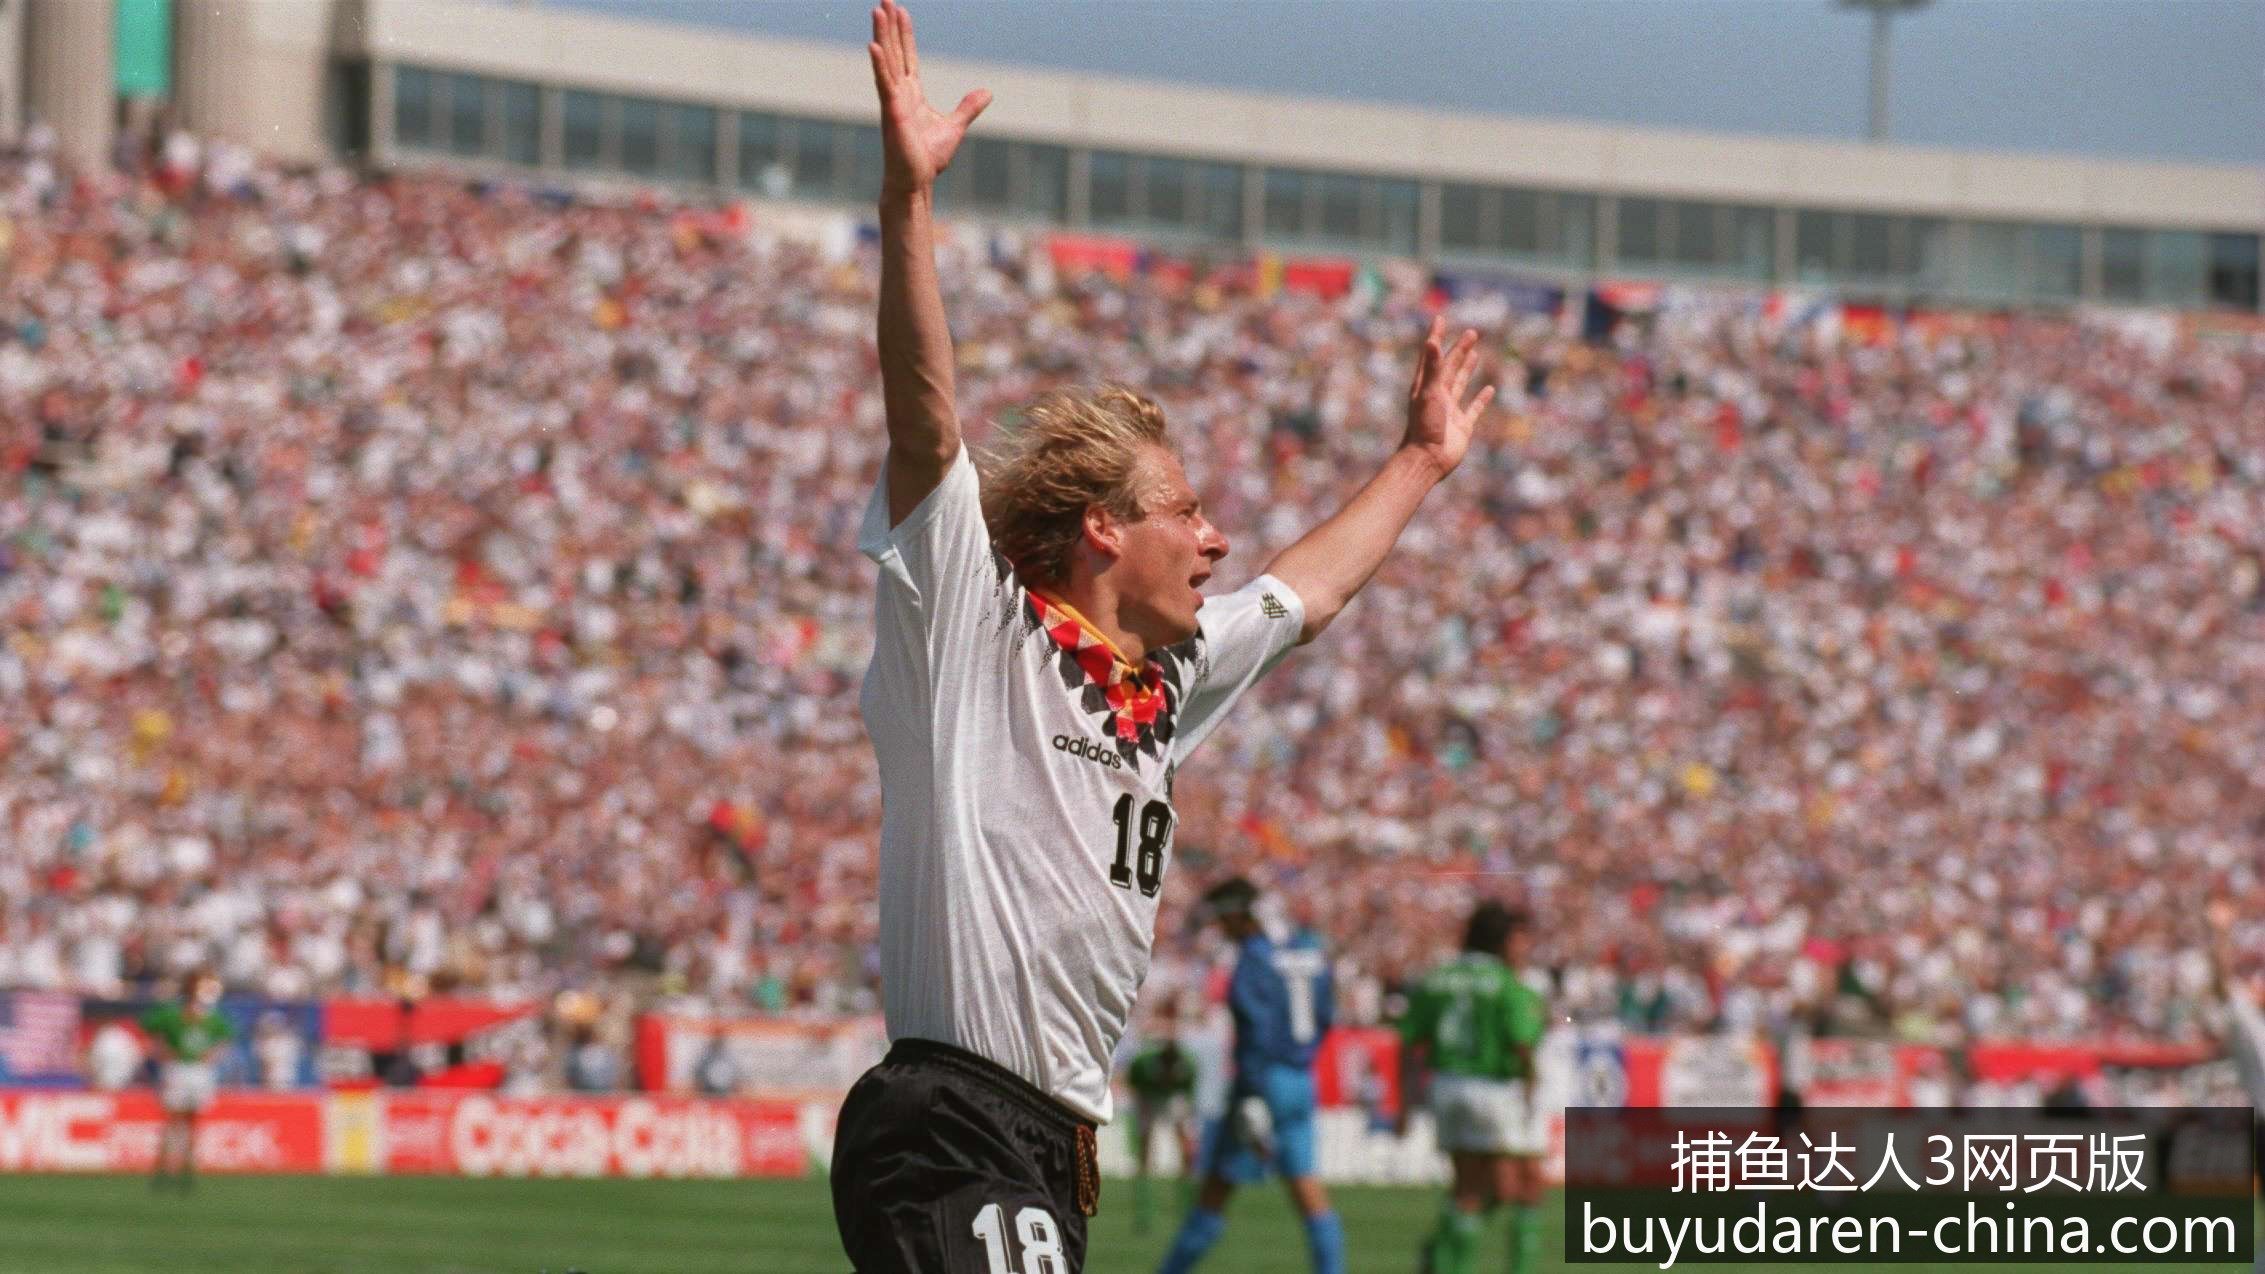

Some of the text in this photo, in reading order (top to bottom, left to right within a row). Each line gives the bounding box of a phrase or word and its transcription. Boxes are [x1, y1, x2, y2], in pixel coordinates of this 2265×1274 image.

[1052, 734, 1122, 770] adidas
[1109, 792, 1173, 899] 18
[1271, 949, 1325, 1045] 1
[452, 1096, 743, 1178] Coca-Cola
[971, 1202, 1069, 1274] 18
